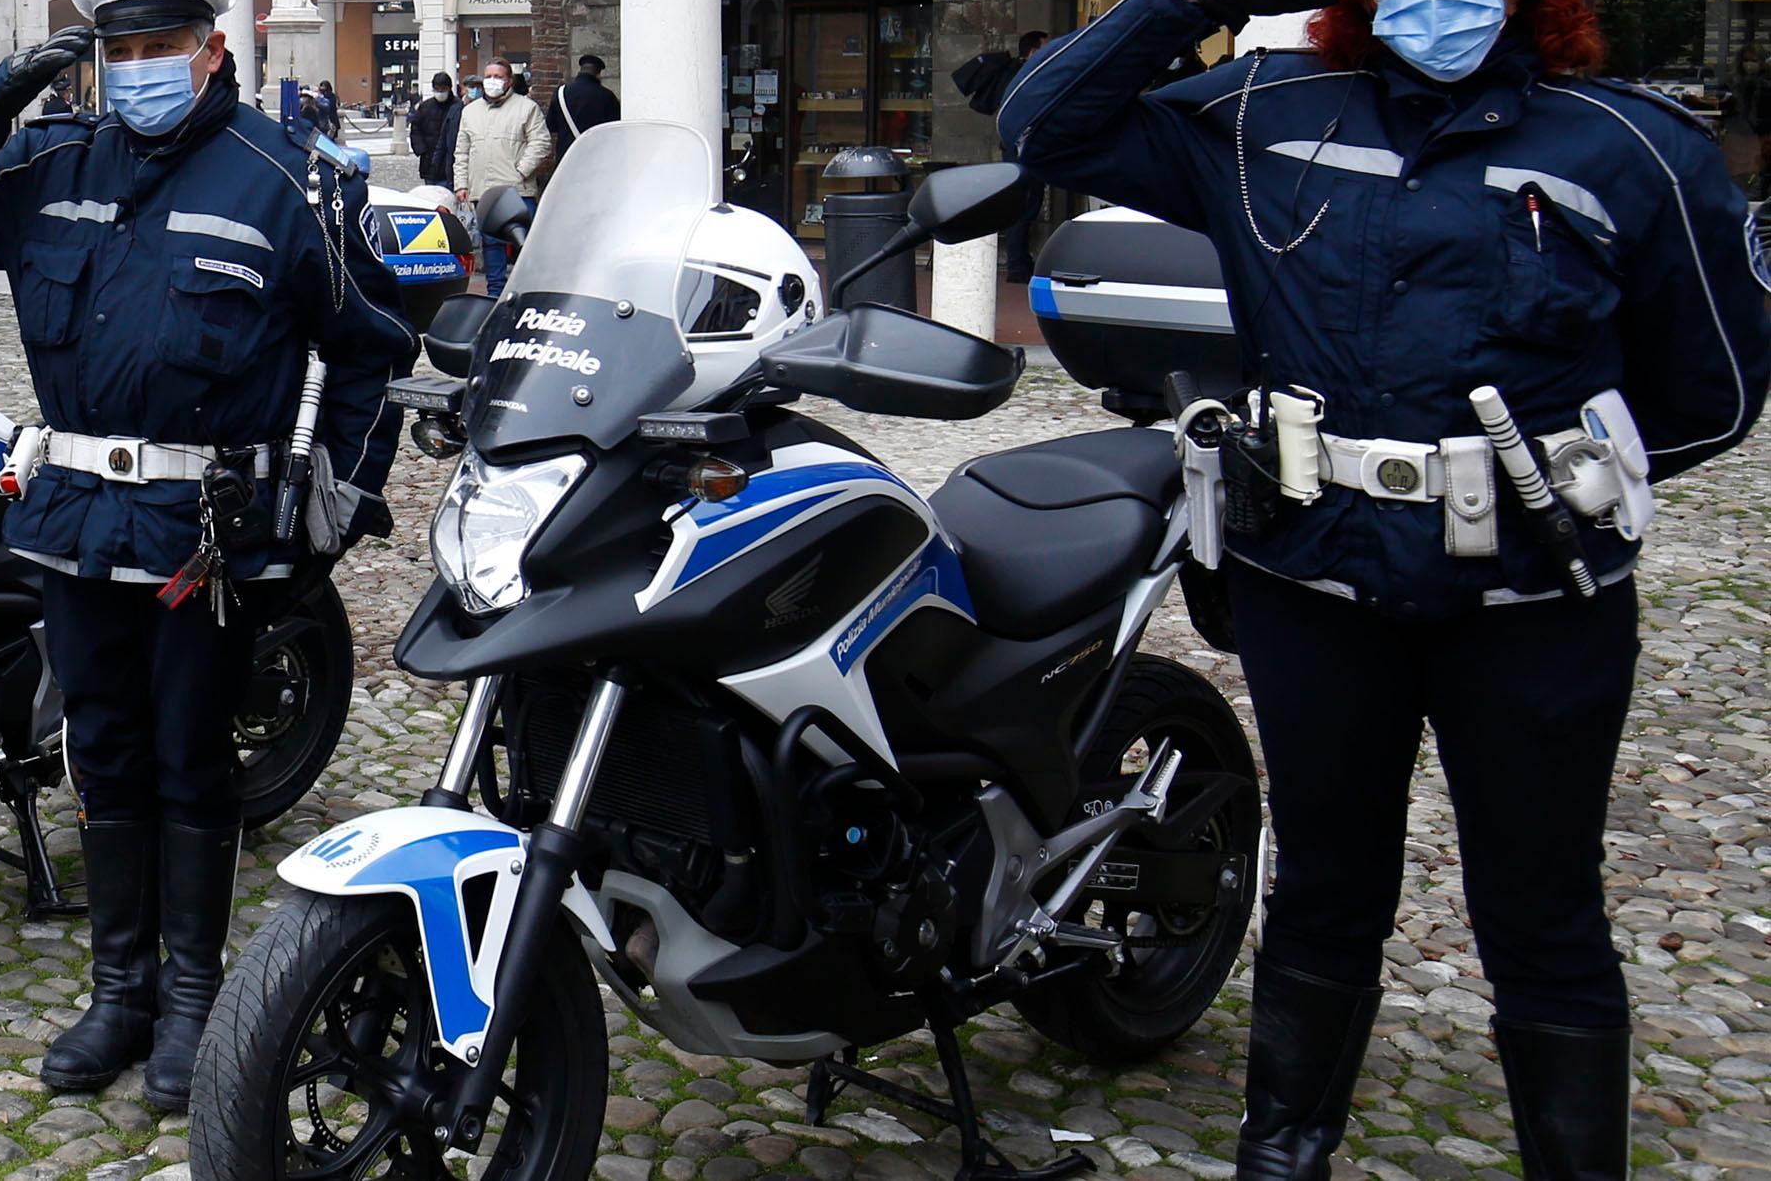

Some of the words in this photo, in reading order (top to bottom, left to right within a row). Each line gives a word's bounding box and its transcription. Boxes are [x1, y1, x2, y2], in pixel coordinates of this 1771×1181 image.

[394, 215, 427, 225] Modena
[413, 262, 457, 276] Municipale
[515, 307, 587, 337] Polizia
[489, 337, 601, 376] Municipale
[488, 399, 528, 413] HONDA
[835, 617, 868, 663] Polizia
